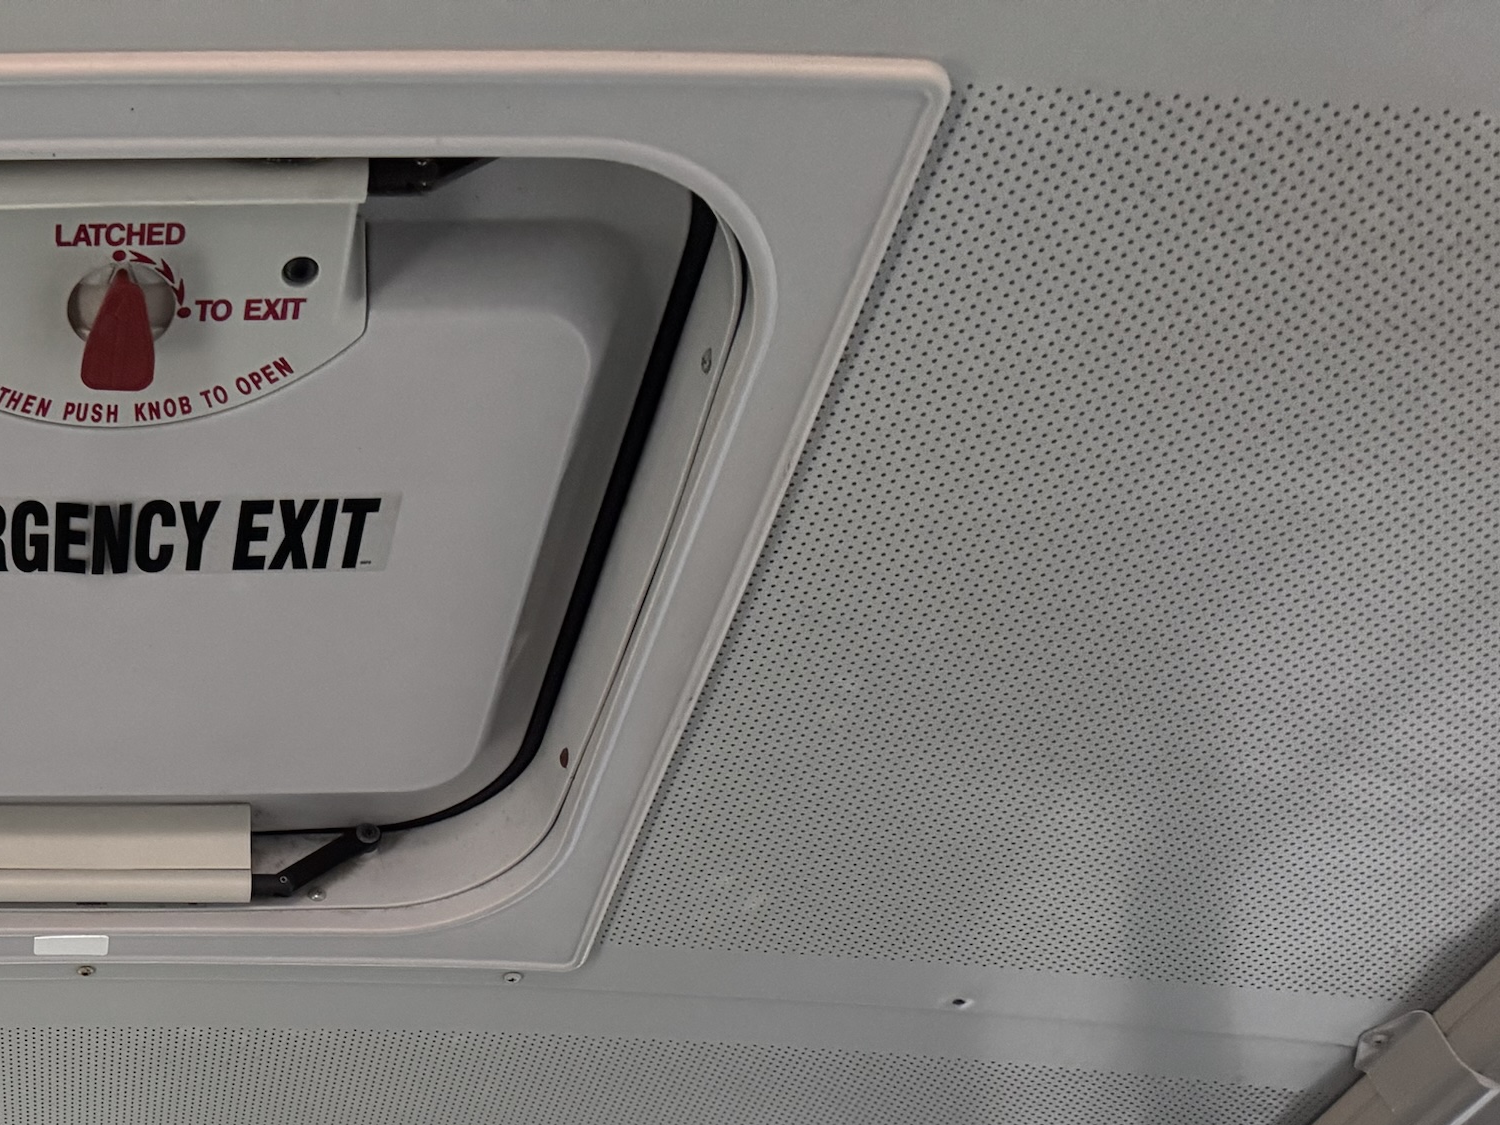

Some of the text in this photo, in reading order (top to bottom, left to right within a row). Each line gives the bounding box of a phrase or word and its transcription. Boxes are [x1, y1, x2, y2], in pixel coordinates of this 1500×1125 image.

[55, 223, 186, 247] LATCHED
[195, 298, 307, 322] TO EXIT
[62, 402, 119, 423] PUSH
[134, 396, 193, 422] KNOB
[199, 385, 229, 409] TO
[235, 356, 295, 396] OPEN
[232, 498, 382, 571] EXIT
